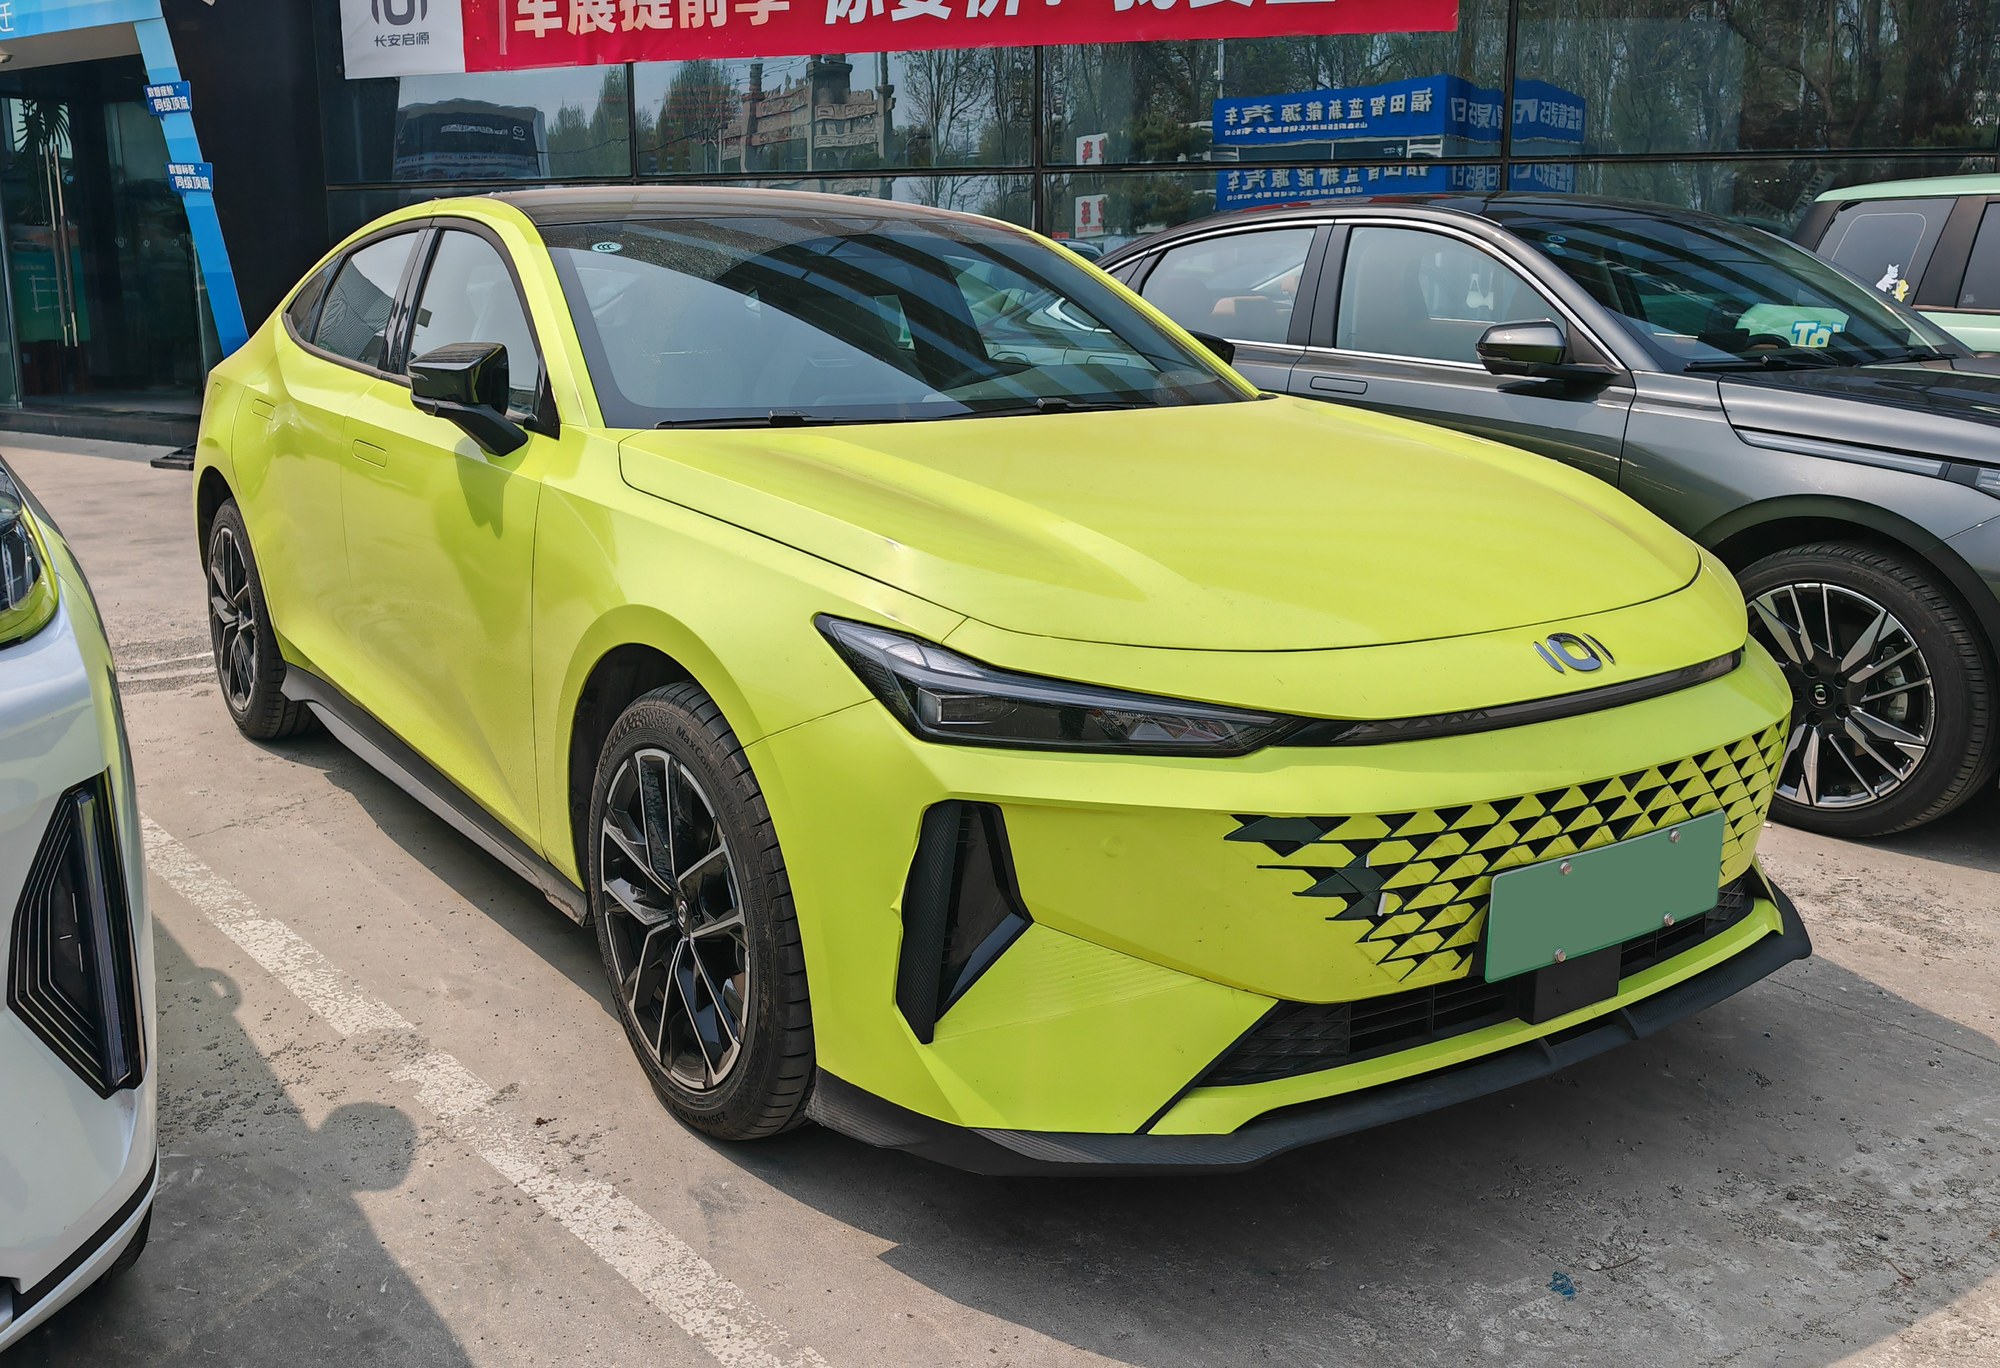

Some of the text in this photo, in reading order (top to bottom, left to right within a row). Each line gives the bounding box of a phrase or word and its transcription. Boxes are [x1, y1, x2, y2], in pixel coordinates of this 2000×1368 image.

[374, 31, 430, 48] 长安启源
[153, 96, 191, 112] 同级顶流
[174, 176, 212, 190] 同级顶流
